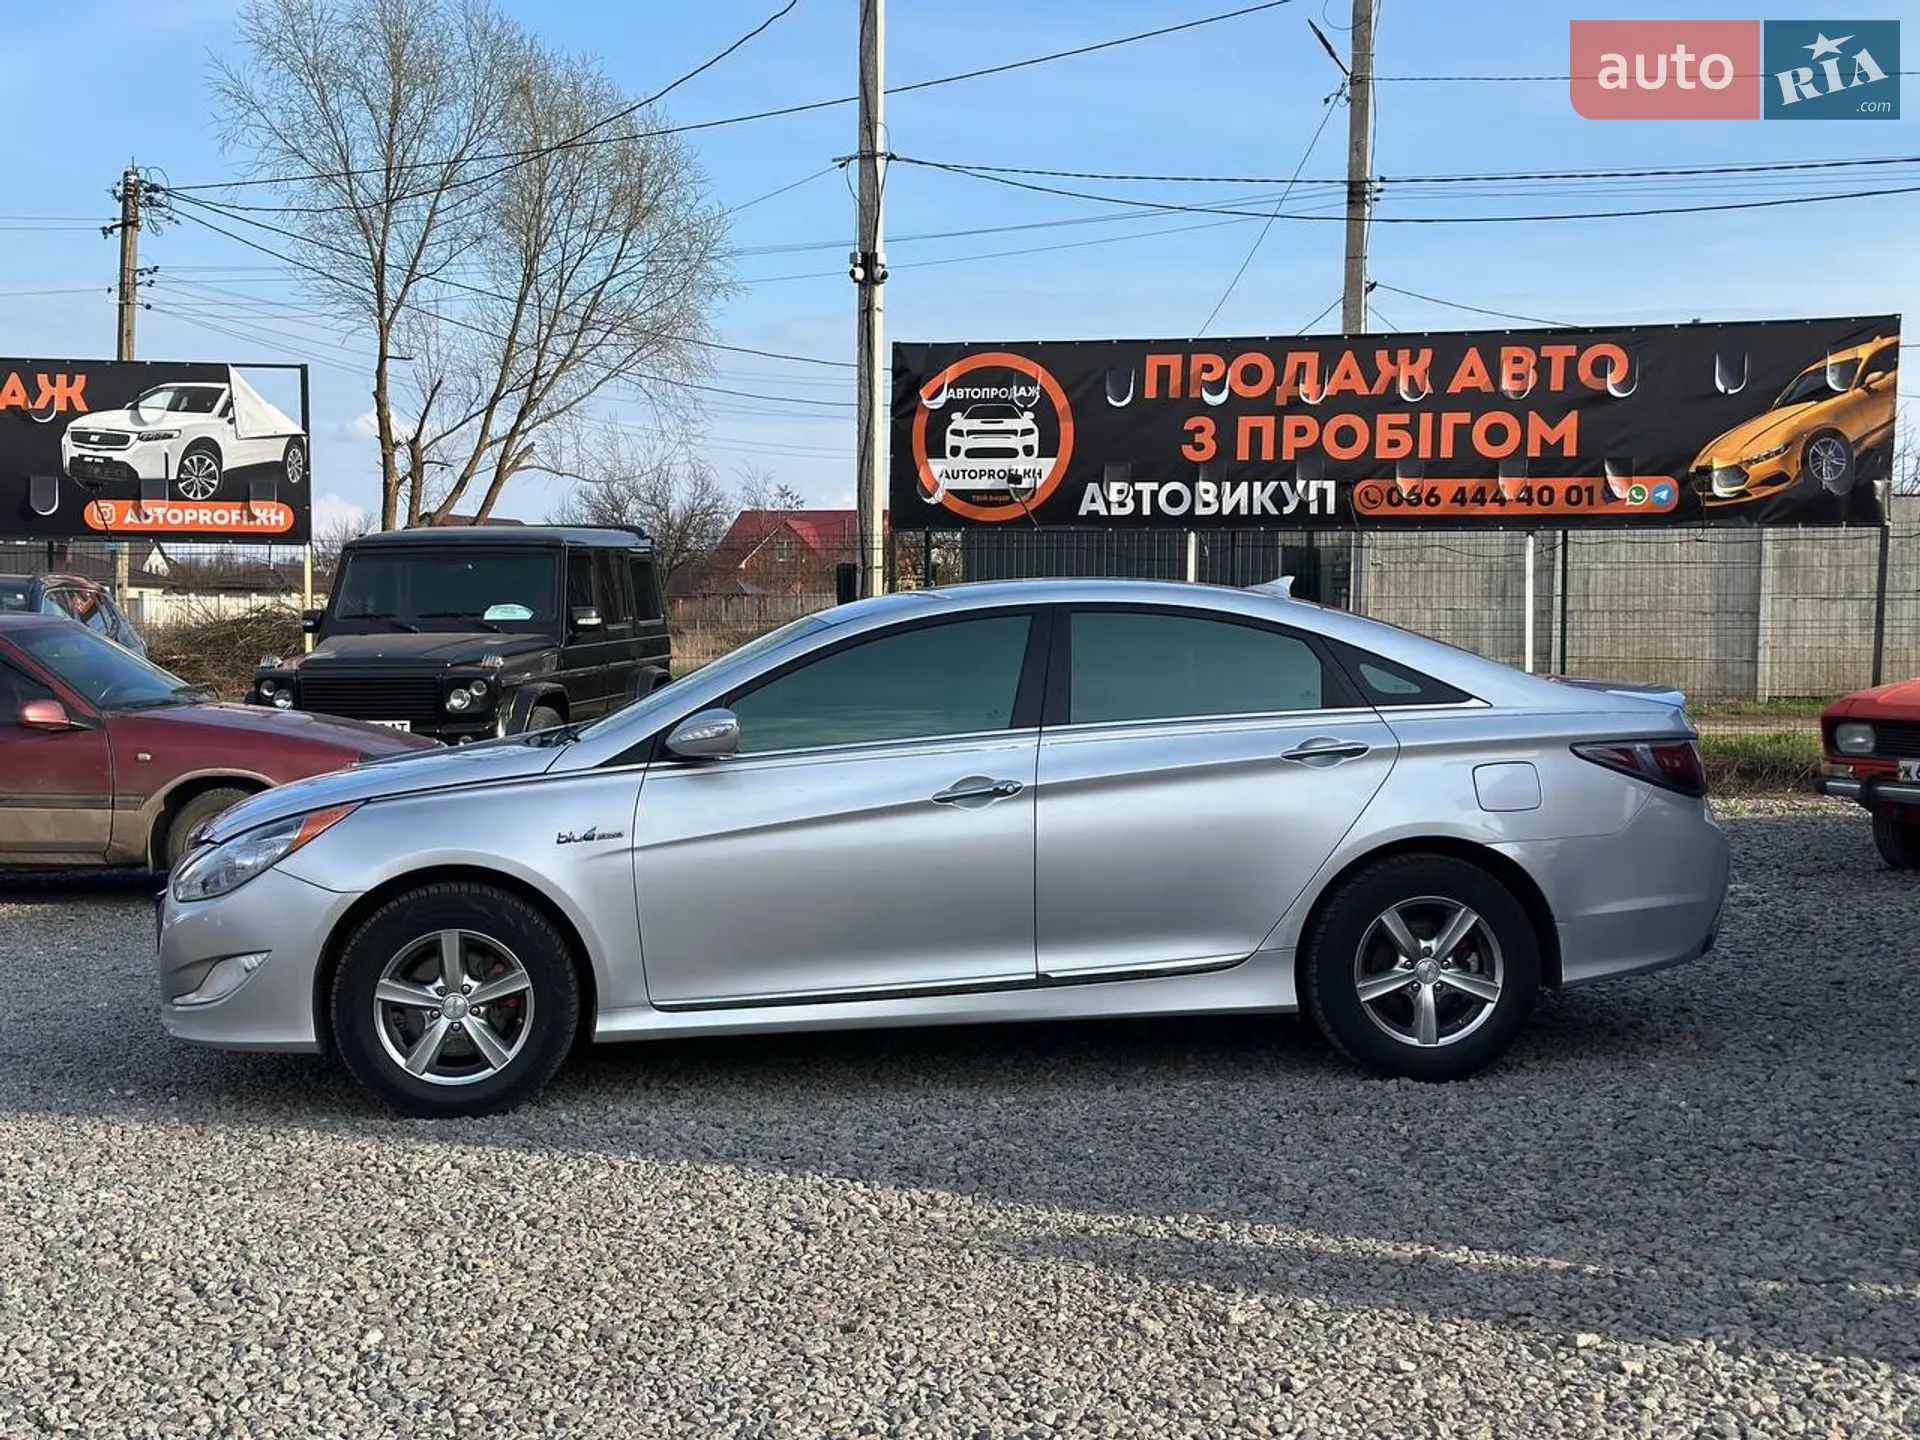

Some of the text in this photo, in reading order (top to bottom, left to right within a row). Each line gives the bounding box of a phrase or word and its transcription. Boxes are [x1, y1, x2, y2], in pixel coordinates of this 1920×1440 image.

[1146, 343, 1630, 405] ПРОДАЖ АВТО
[1182, 410, 1580, 462] З ПРОБІГОМ
[1078, 480, 1336, 516] АВТОВИКУП
[1515, 484, 1555, 507] 40
[1564, 484, 1595, 506] 01
